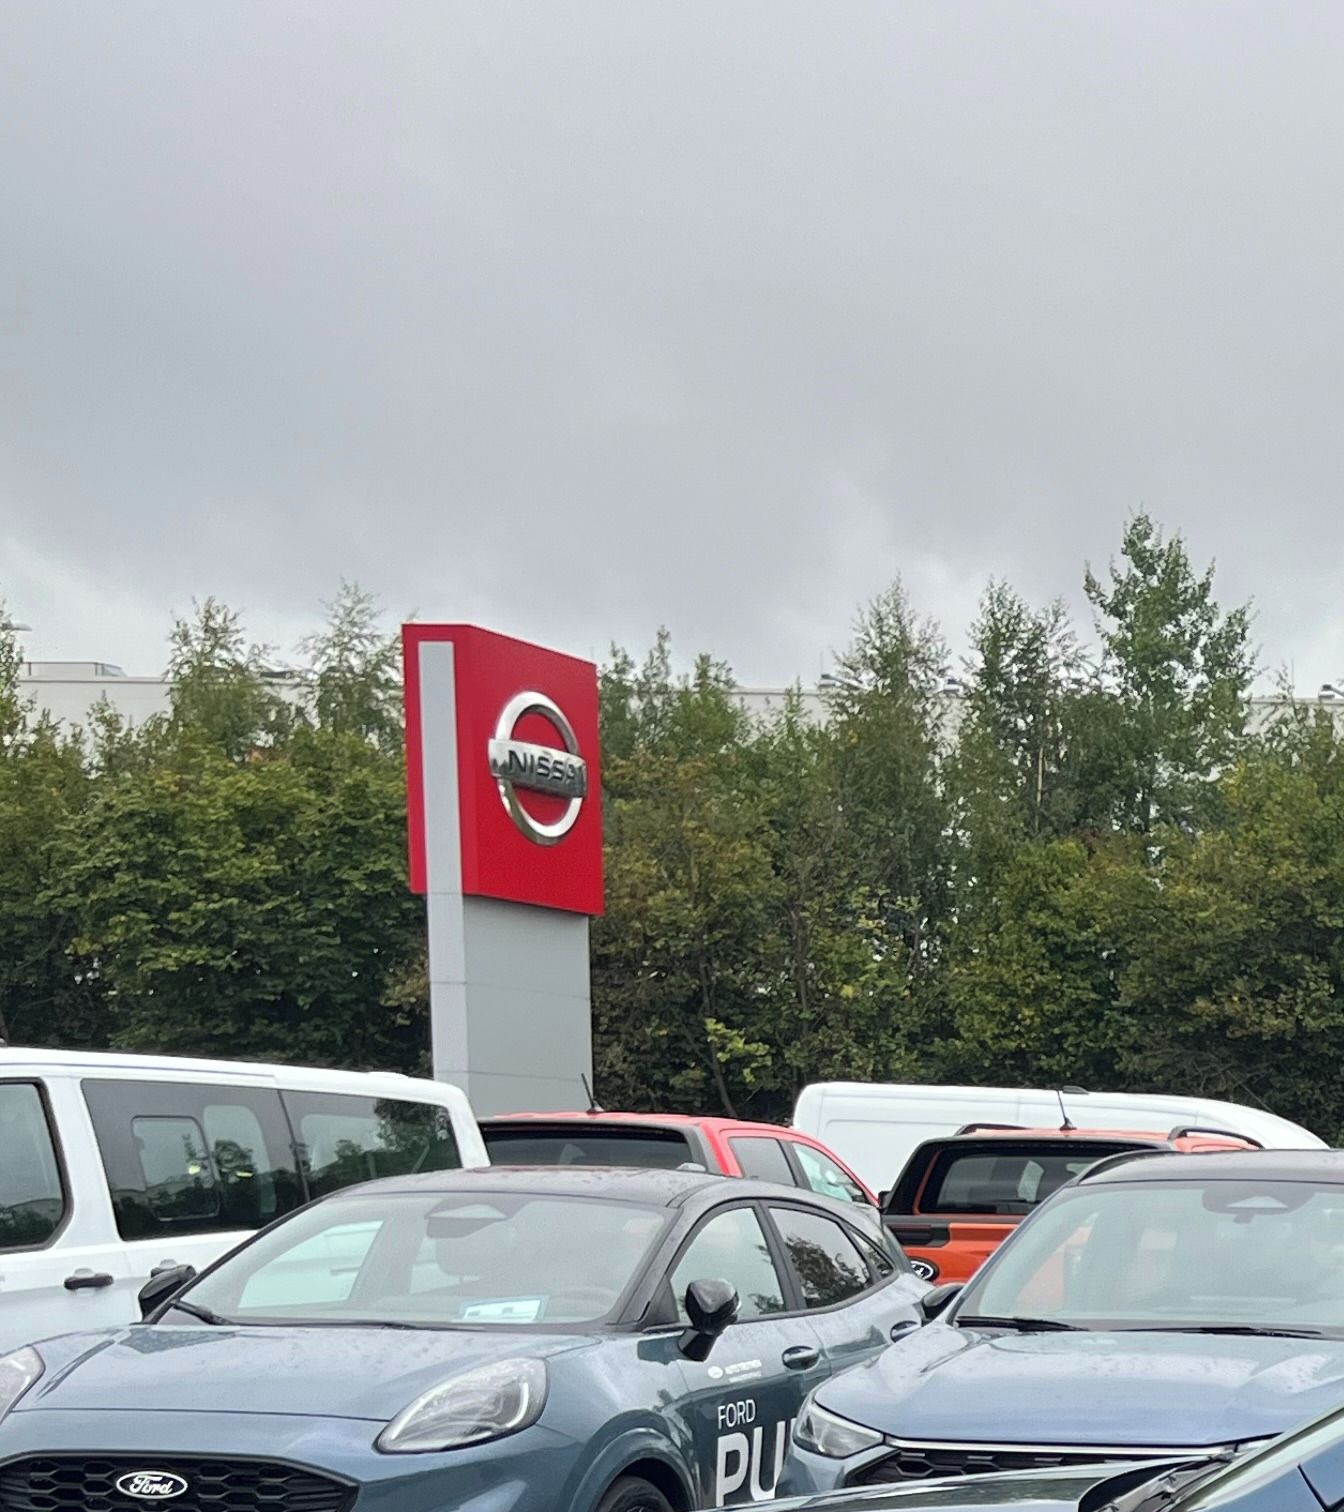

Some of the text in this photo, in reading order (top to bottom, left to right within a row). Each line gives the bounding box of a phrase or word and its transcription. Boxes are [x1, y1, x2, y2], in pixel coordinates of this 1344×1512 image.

[718, 1399, 756, 1430] FORD
[715, 1418, 797, 1507] PU
[129, 1475, 174, 1495] Ford
